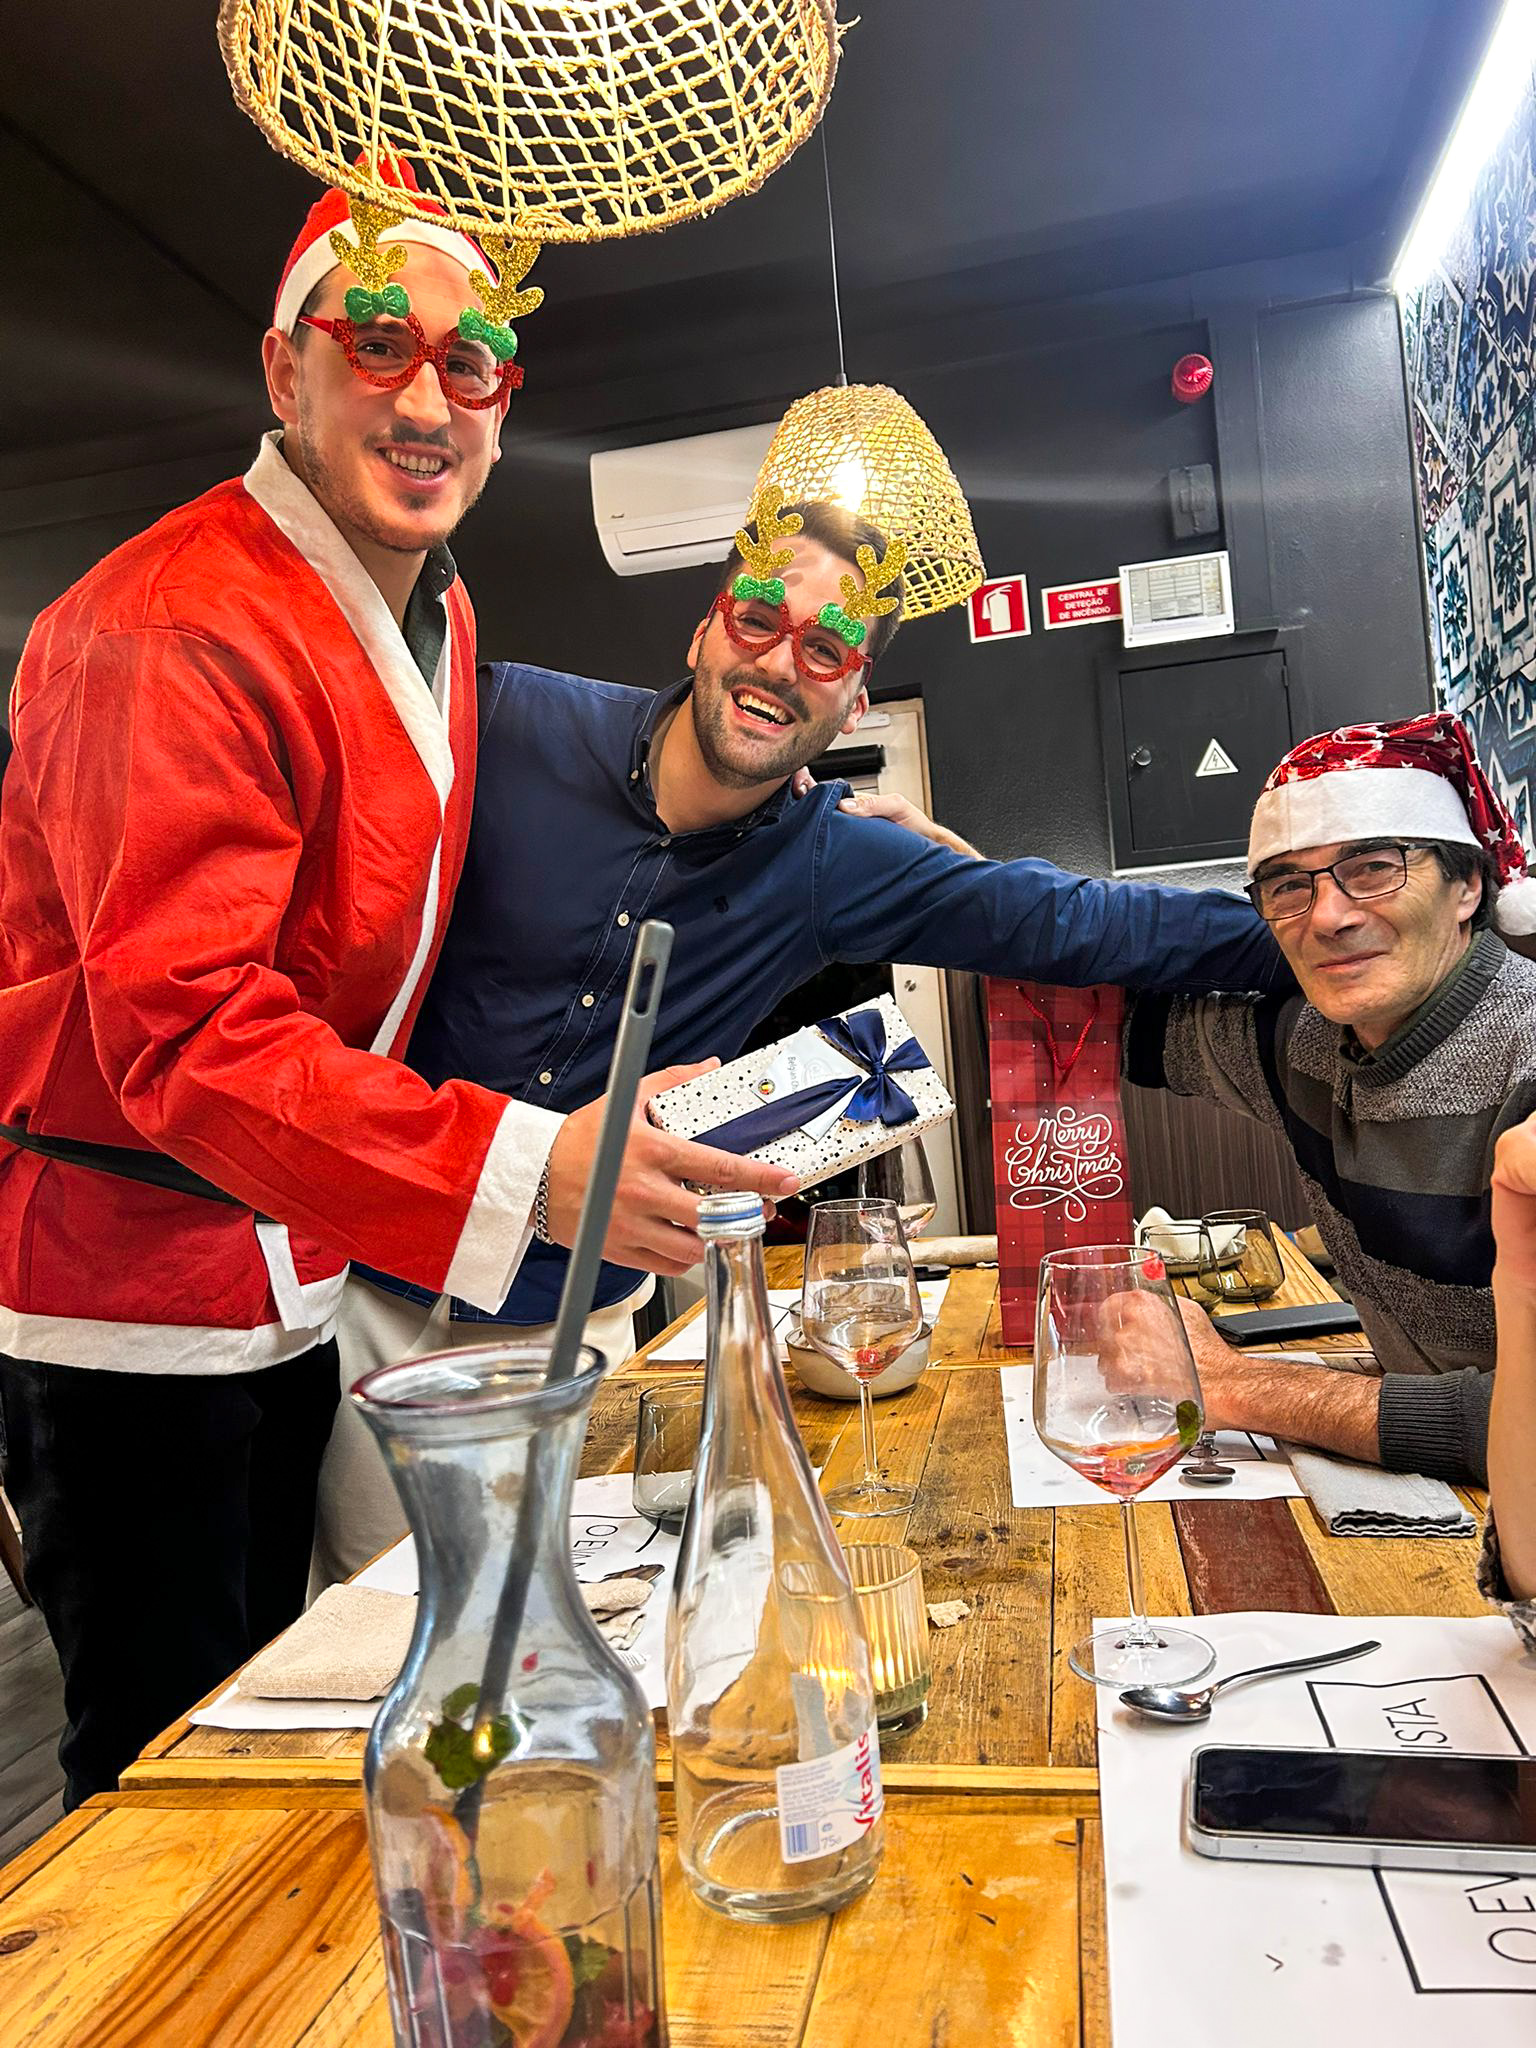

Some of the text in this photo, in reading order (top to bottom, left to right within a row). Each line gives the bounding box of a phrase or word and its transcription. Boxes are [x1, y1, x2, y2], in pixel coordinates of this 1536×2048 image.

[1058, 587, 1109, 601] CENTRAL DE
[1059, 611, 1071, 620] DE
[1072, 605, 1111, 618] INCÊNDIO
[1065, 598, 1103, 610] DETEÇÃO
[1015, 1106, 1112, 1153] Merry
[1005, 1143, 1123, 1222] Christmas
[586, 1524, 618, 1537] O
[1382, 1697, 1453, 1749] ISTA
[853, 1732, 875, 1836] Vitalis
[1463, 1873, 1536, 1913] EV
